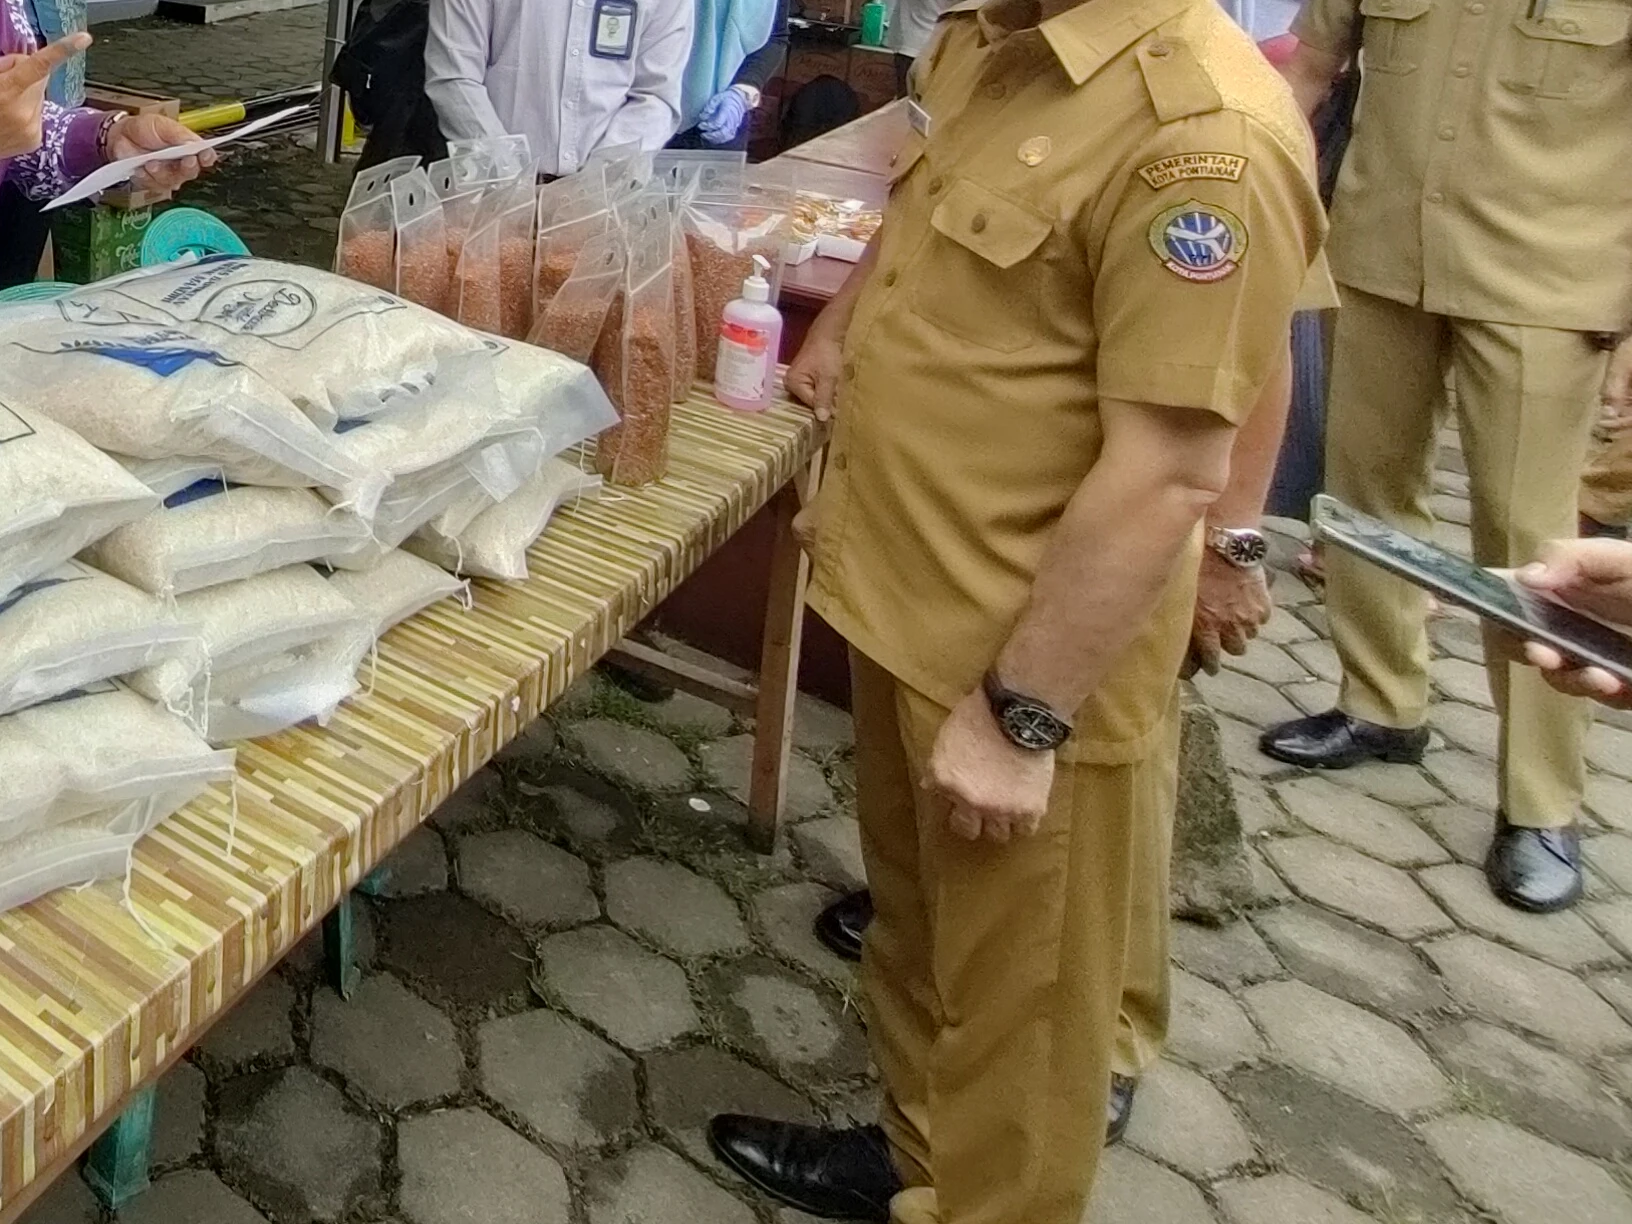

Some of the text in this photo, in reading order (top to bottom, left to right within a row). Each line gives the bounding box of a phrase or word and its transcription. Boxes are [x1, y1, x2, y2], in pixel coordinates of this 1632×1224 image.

[1145, 155, 1239, 175] PEMERINTAH
[1152, 166, 1236, 186] KOTA PONTIANAK
